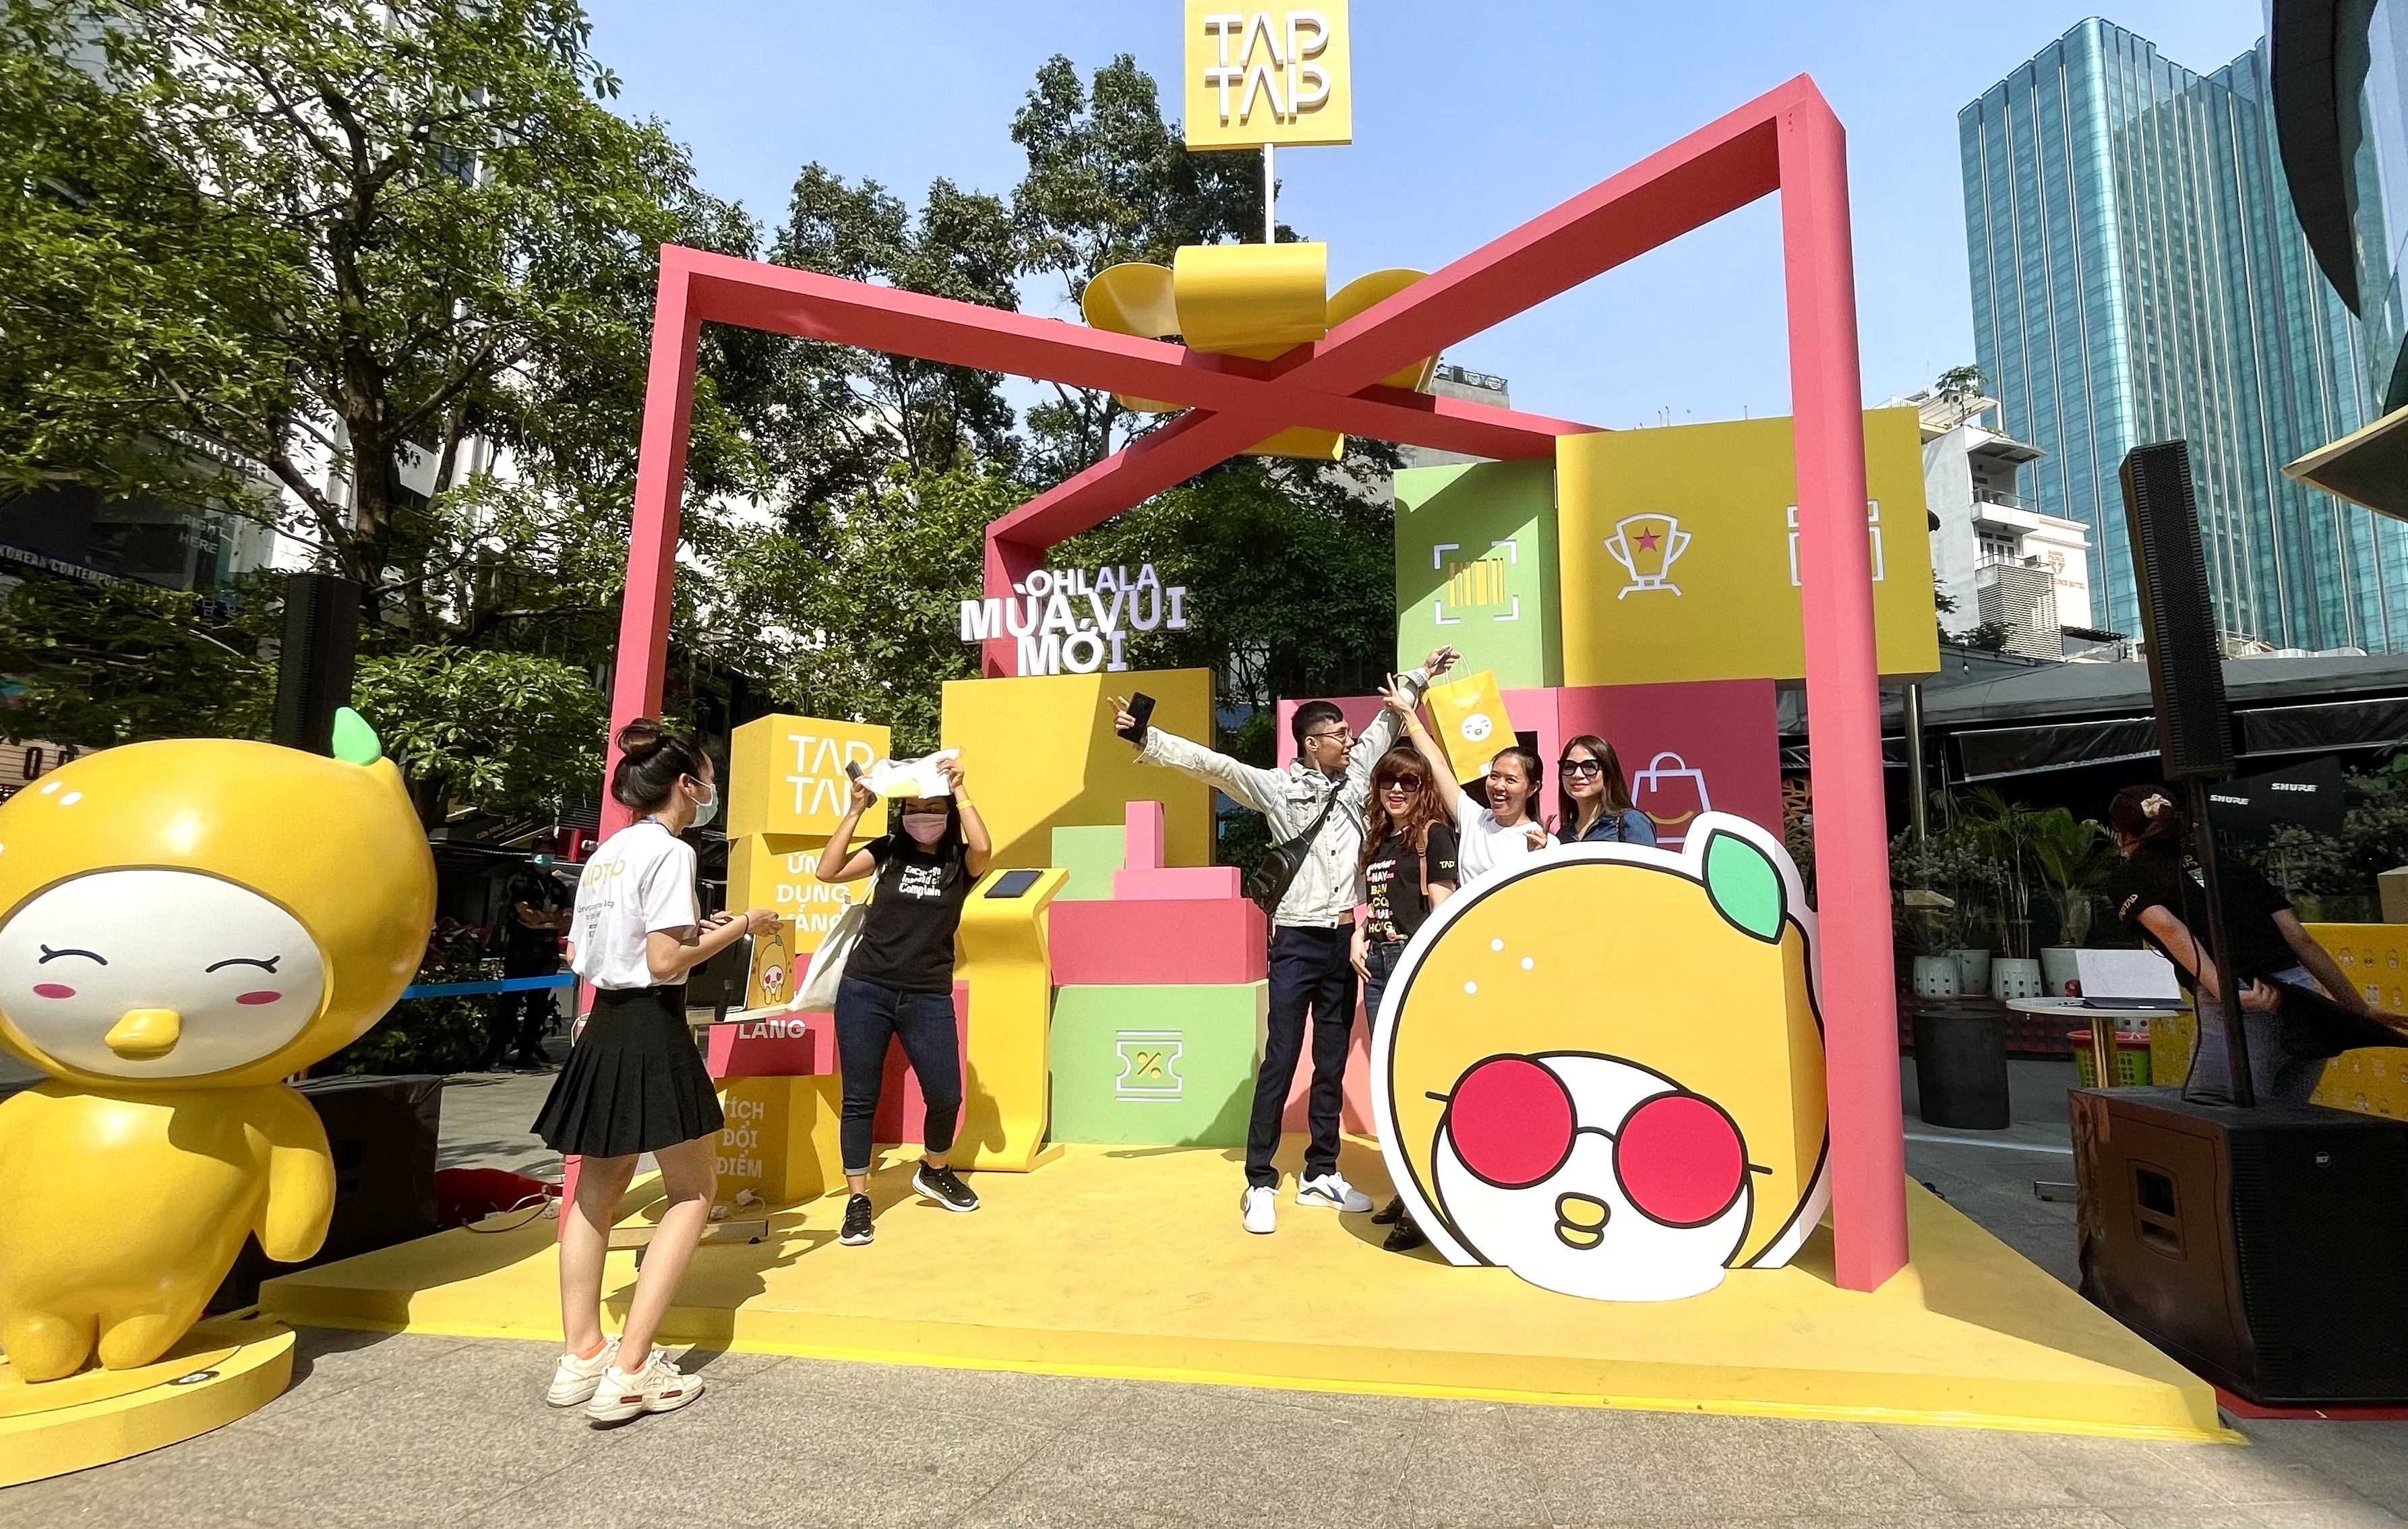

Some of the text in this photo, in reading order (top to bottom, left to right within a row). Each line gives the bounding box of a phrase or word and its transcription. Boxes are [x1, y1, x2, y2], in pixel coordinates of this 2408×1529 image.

[1204, 10, 1329, 70] TAP
[1204, 63, 1331, 127] TAP
[179, 532, 219, 555] HERE
[787, 734, 876, 777] TAP
[2270, 782, 2319, 793] SHURE
[2209, 794, 2251, 806] SHURE
[1371, 870, 1388, 883] NAY
[899, 882, 941, 900] Complain
